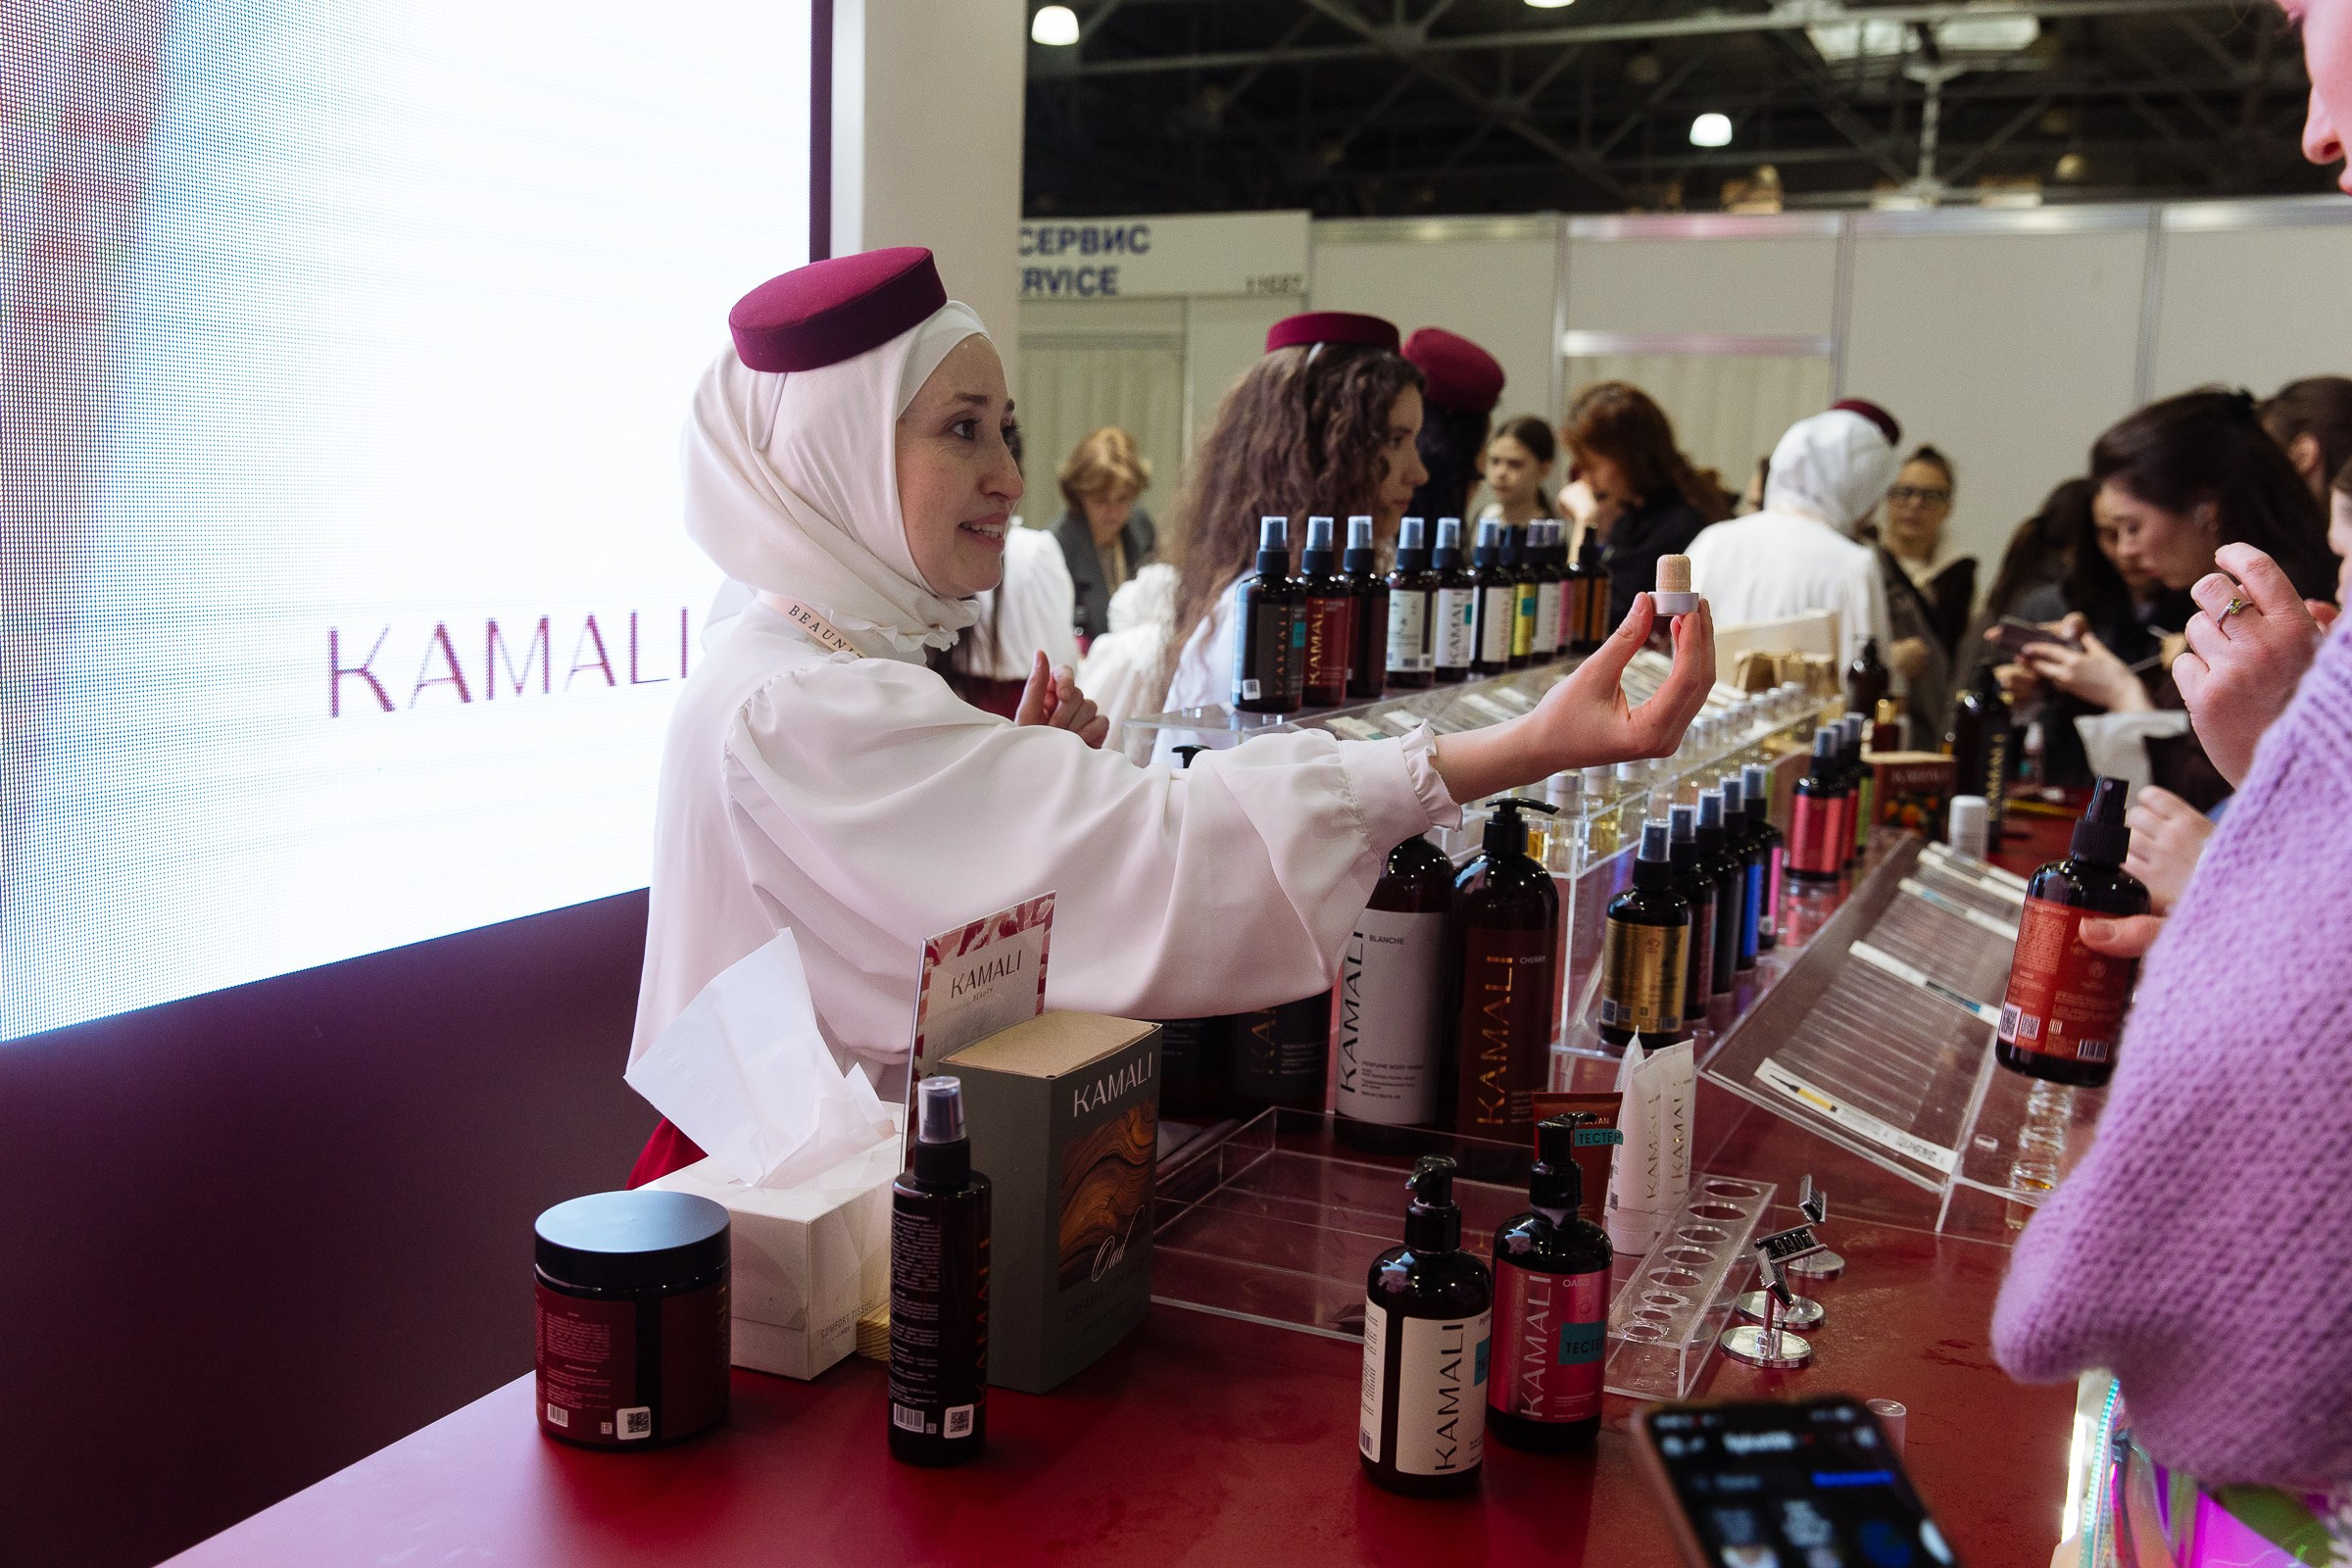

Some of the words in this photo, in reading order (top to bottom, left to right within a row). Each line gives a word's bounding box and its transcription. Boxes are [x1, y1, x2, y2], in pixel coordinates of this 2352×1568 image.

[329, 606, 690, 718] KAMALI
[1308, 599, 1325, 685] KAMALI
[951, 949, 1022, 1000] KAMALI
[1369, 934, 1405, 946] BLANCHE
[1519, 955, 1546, 965] CHERRY
[972, 987, 994, 1003] BEAUTY
[1340, 930, 1364, 1095] KAMALI
[1475, 956, 1514, 1125] KAMALI
[1073, 1052, 1152, 1118] KAMALI
[1092, 1204, 1145, 1282] Oud
[1562, 1278, 1591, 1288] OASIS
[820, 1314, 850, 1340] COMFORT
[851, 1299, 873, 1320] TISSUE
[1521, 1275, 1552, 1417] KAMALI
[1435, 1324, 1465, 1470] KAMALI
